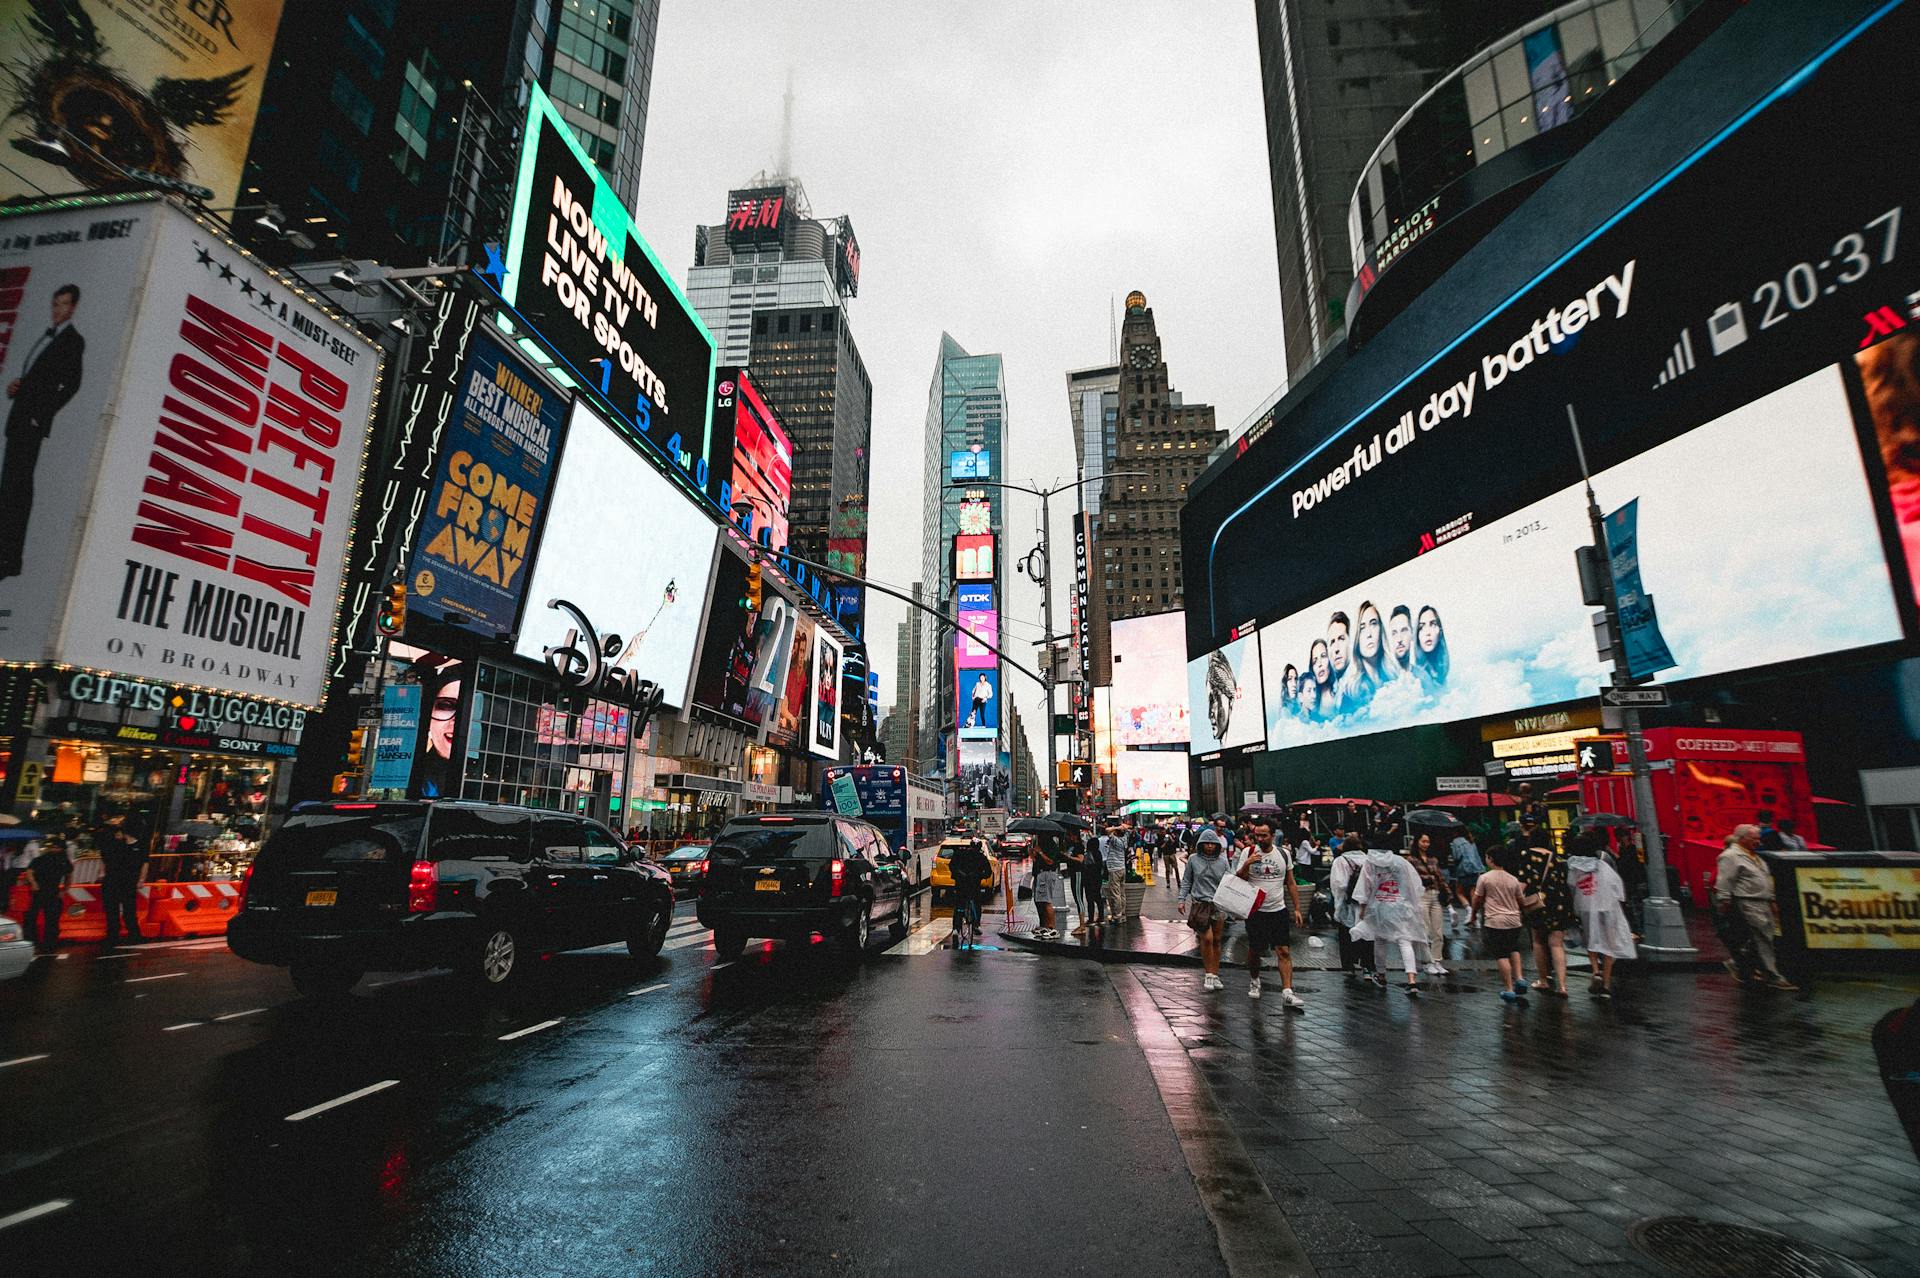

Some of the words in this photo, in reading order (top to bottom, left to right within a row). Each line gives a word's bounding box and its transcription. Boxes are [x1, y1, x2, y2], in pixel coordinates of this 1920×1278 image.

[159, 5, 218, 55] CHILD
[729, 197, 784, 231] H&M
[1376, 196, 1440, 260] MARRIOTT
[547, 218, 600, 297] LIVE
[602, 277, 632, 329] TV
[553, 175, 608, 263] NOW
[611, 250, 658, 330] WITH
[1378, 217, 1434, 272] MARQUIS
[1752, 207, 1902, 330] 20:37
[278, 301, 288, 321] A
[542, 251, 590, 330] FOR
[592, 311, 670, 415] SPORTS.
[469, 370, 504, 413] BEST
[502, 396, 551, 452] MUSICAL
[496, 362, 543, 417] WINNER!
[718, 398, 732, 407] LG
[1291, 435, 1382, 519] Powerful
[1384, 410, 1416, 455] all
[1418, 371, 1477, 417] day
[1482, 259, 1636, 391] battery
[131, 294, 274, 571] WOMAN
[464, 396, 477, 413] ALL
[478, 408, 505, 432] ACROSS
[504, 425, 524, 447] NORTH
[523, 439, 548, 464] AMERICA
[232, 341, 349, 607] PRETTY
[449, 451, 537, 526] COME
[425, 523, 522, 589] AWAY
[117, 559, 180, 629] THE
[183, 582, 306, 660] MUSICAL
[967, 594, 990, 602] TDK
[1076, 533, 1090, 670] COMMUNICATE
[107, 637, 144, 659] ON
[162, 649, 300, 689] BROADWAY
[543, 598, 665, 740] Disney
[750, 595, 800, 700] 21
[70, 673, 166, 711] GIFTS
[189, 693, 307, 731] LUGGAGE
[1611, 691, 1630, 701] ONE
[1637, 690, 1659, 700] WAY
[117, 726, 158, 741] Nikon
[195, 718, 224, 734] NY
[219, 738, 262, 752] SONY
[379, 738, 403, 746] DEAR
[1676, 738, 1738, 752] COFFEED
[377, 751, 412, 760] HANSEN
[698, 791, 724, 806] FOREVER
